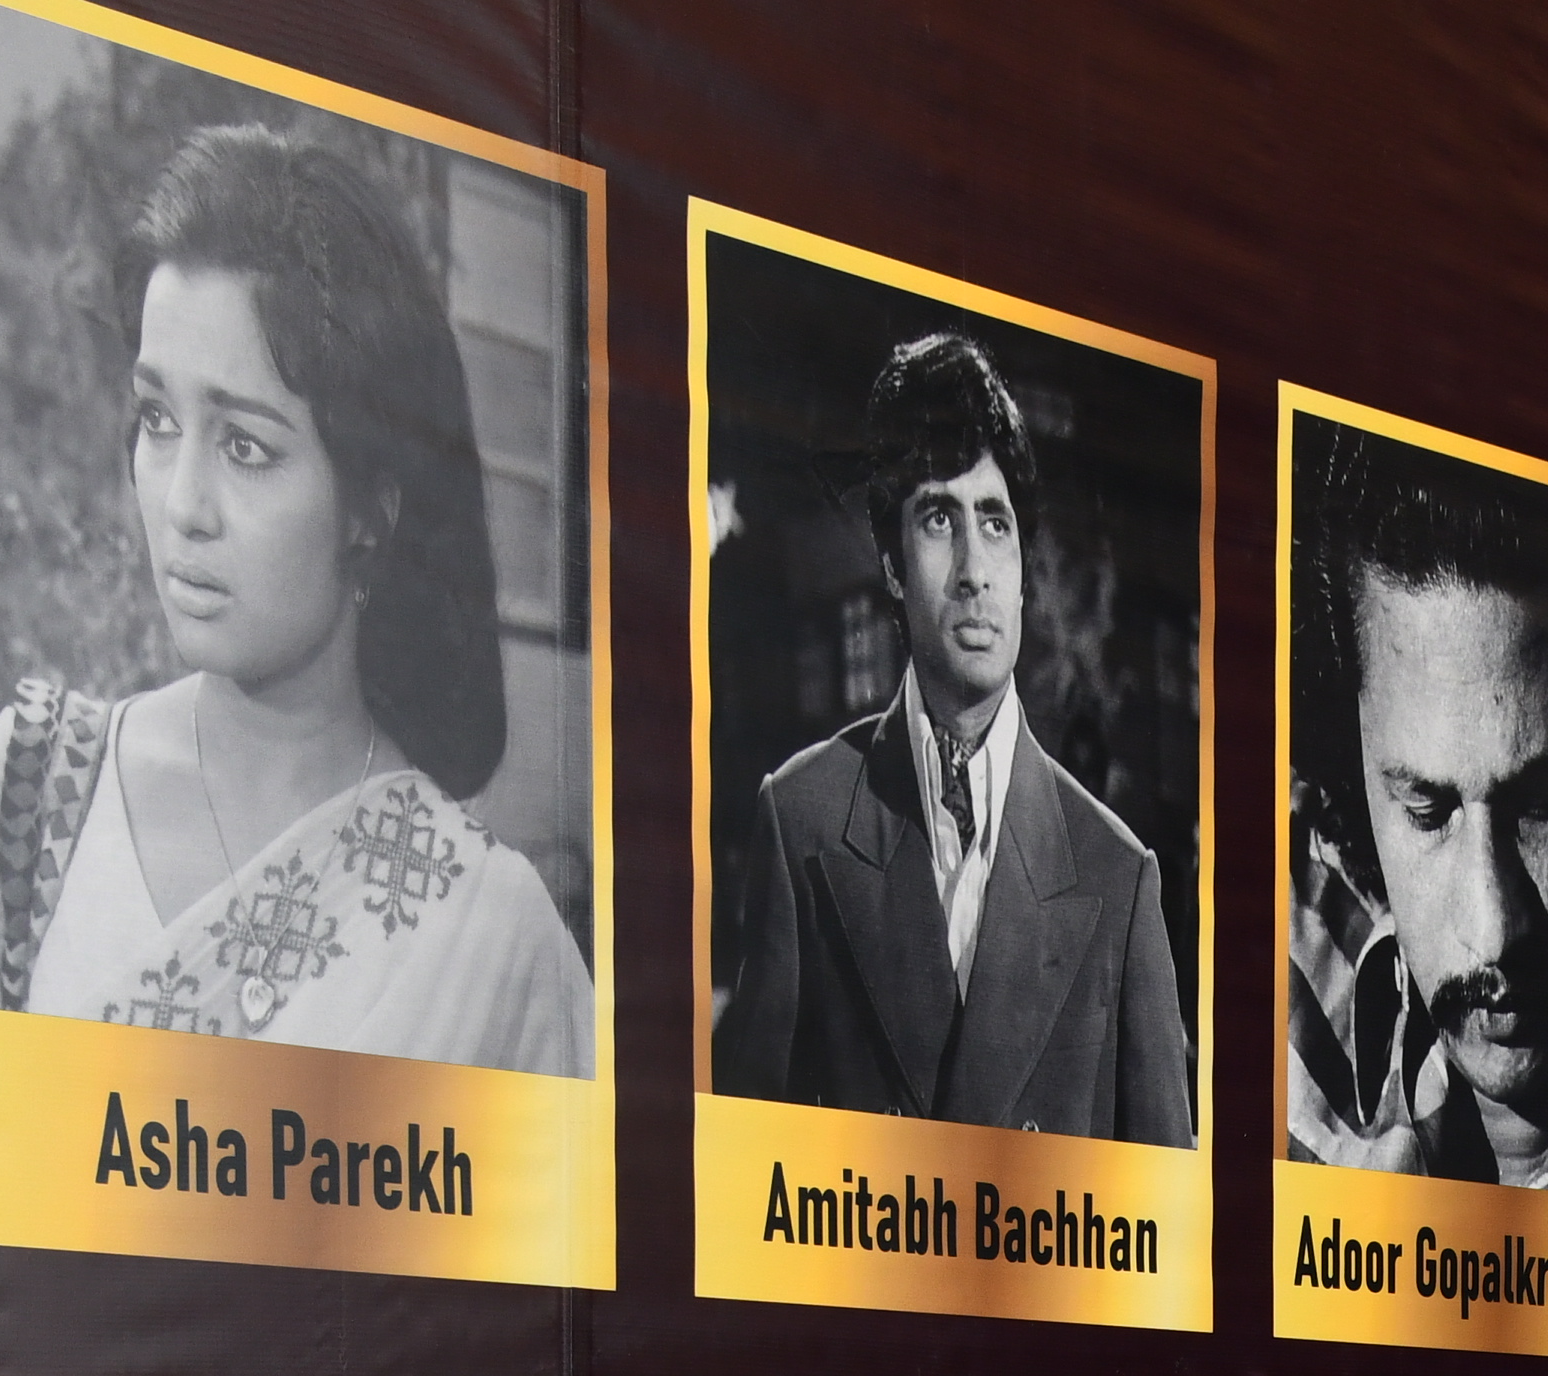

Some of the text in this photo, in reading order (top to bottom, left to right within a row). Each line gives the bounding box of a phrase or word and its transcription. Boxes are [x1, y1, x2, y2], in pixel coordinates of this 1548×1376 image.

[96, 1092, 472, 1215] Asha Parekh
[764, 1162, 1157, 1273] Amitabh Bachhan
[1295, 1215, 1402, 1293] Adoor
